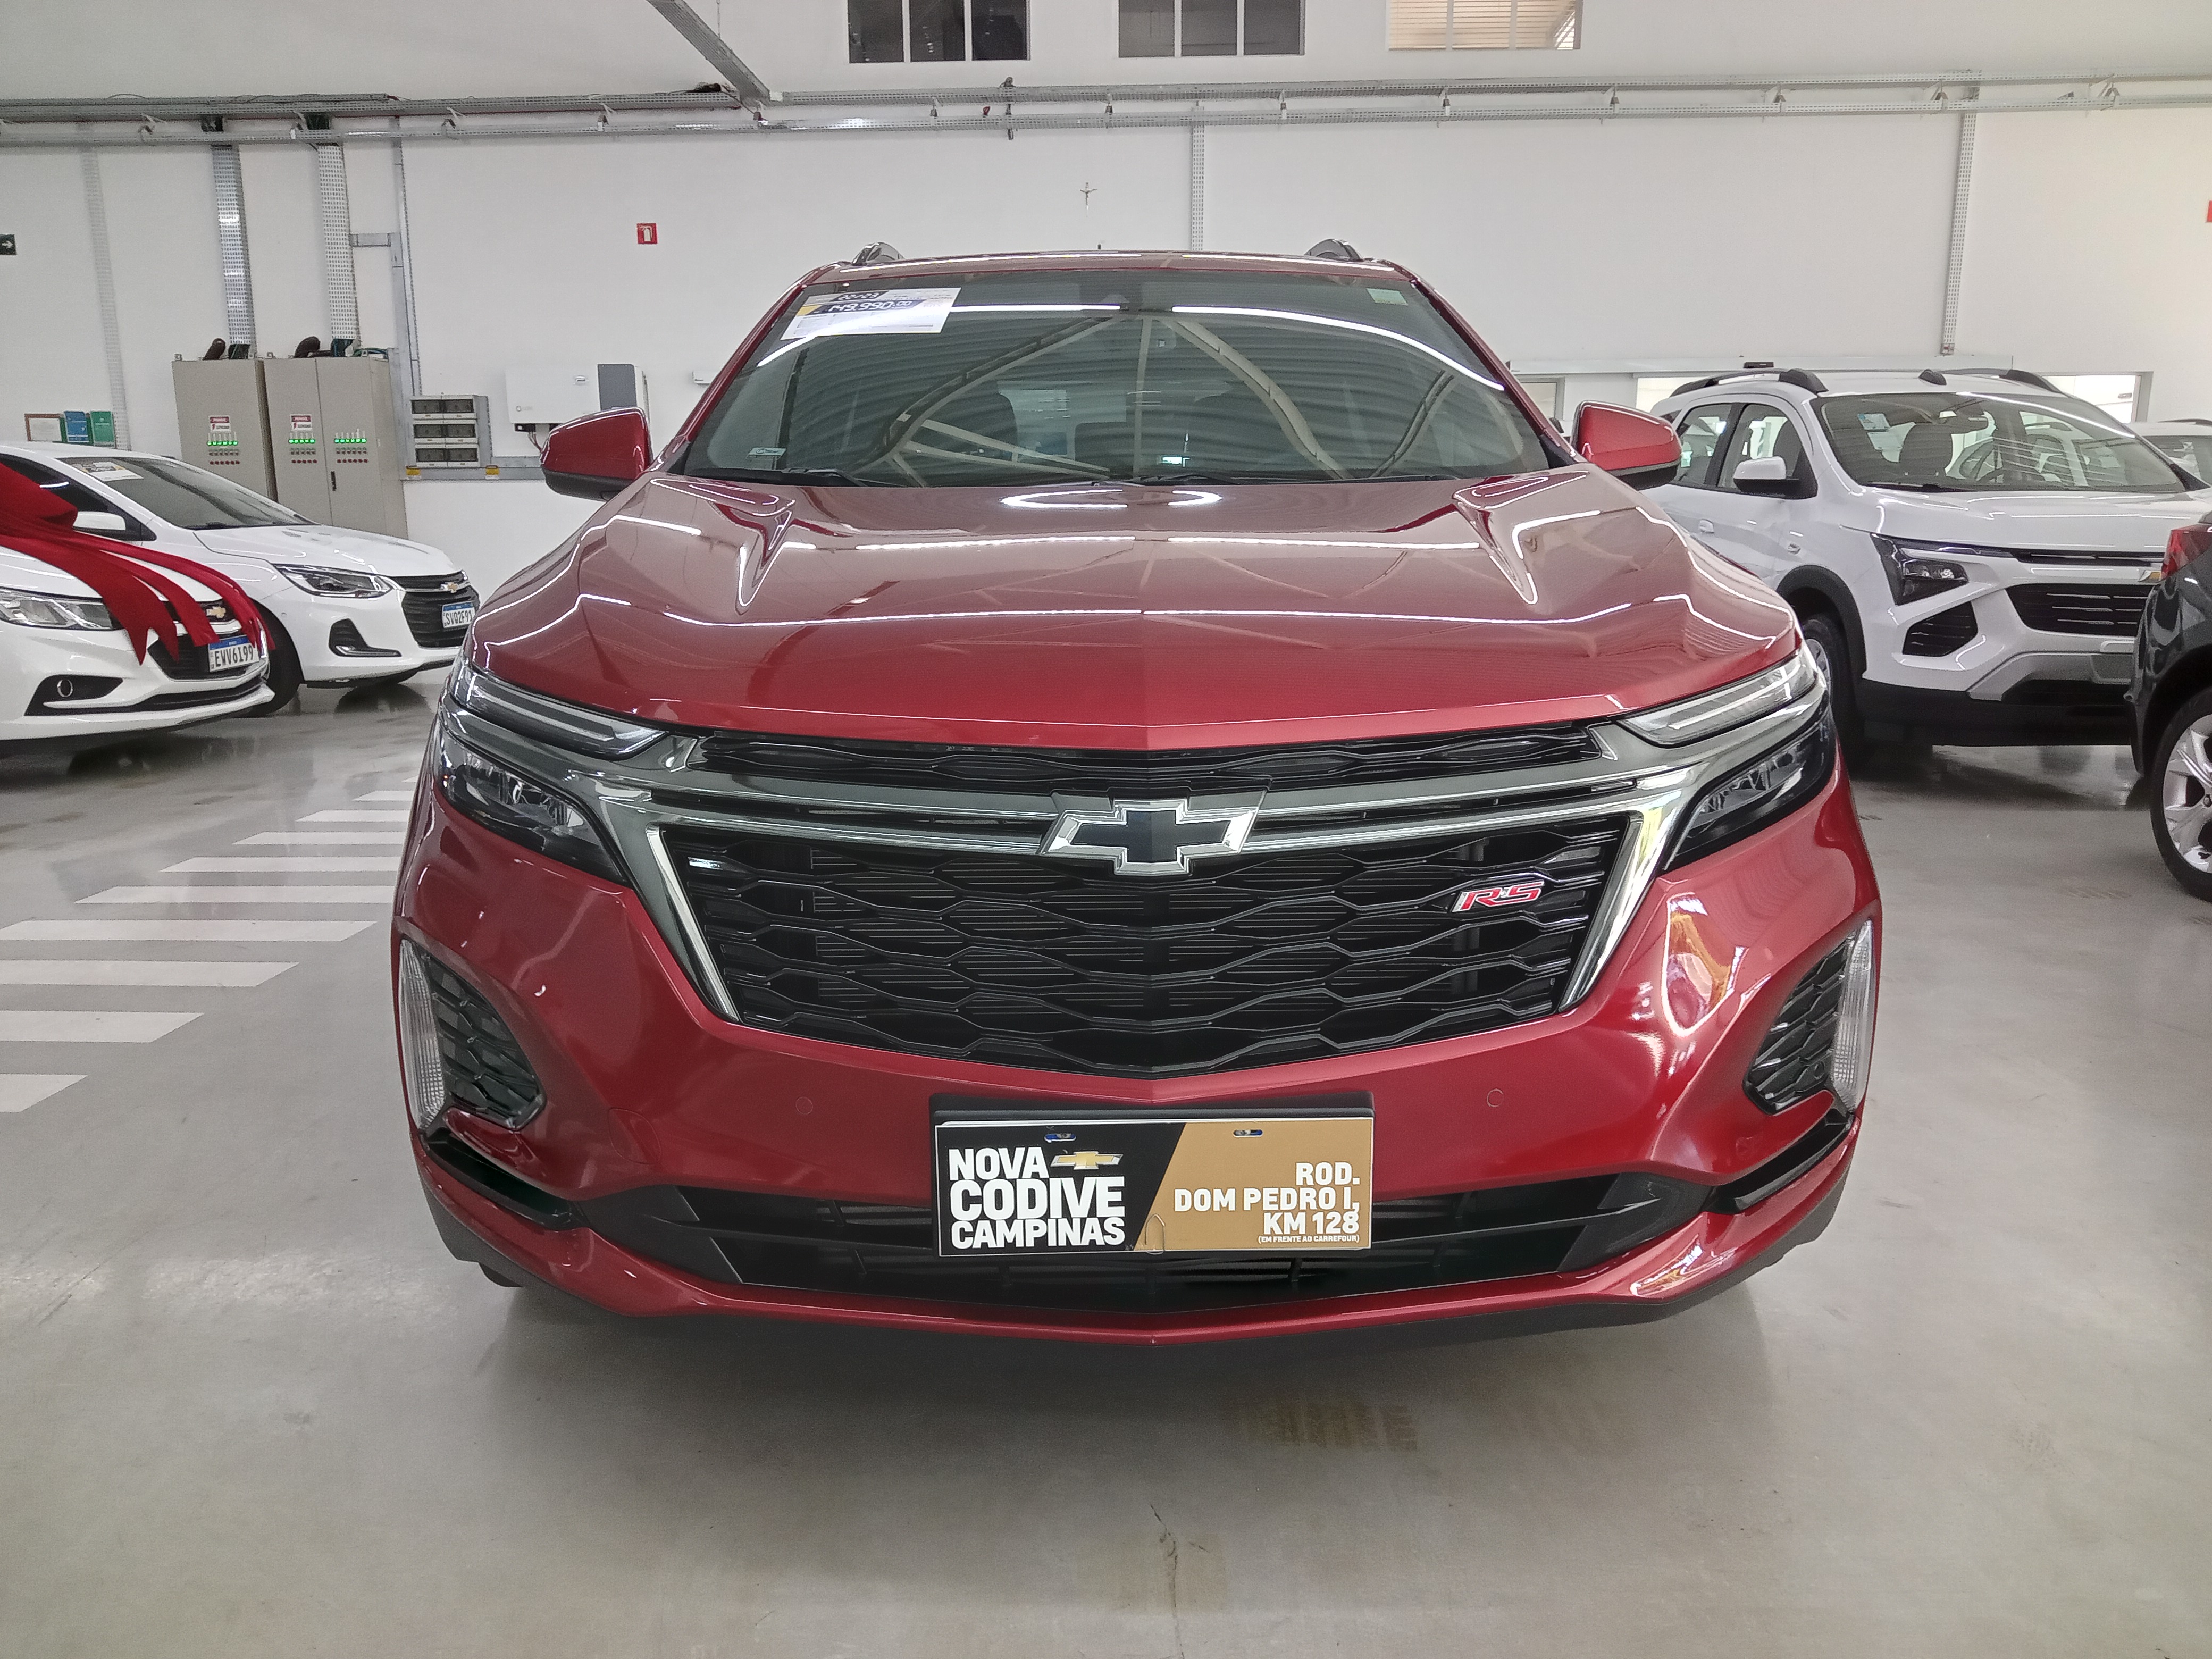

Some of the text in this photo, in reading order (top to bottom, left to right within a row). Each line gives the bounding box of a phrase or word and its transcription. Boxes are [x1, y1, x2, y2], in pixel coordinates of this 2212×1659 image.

[1452, 881, 1544, 912] RS
[949, 1146, 1050, 1180] NOVA
[1296, 1162, 1360, 1186] ROD.
[950, 1176, 1125, 1221] CODIVE
[1174, 1187, 1360, 1213] DOM PEDRO I,
[951, 1217, 1125, 1249] CAMPINAS
[1263, 1211, 1360, 1235] KM 128
[1313, 1235, 1360, 1243] CARREFOUR)
